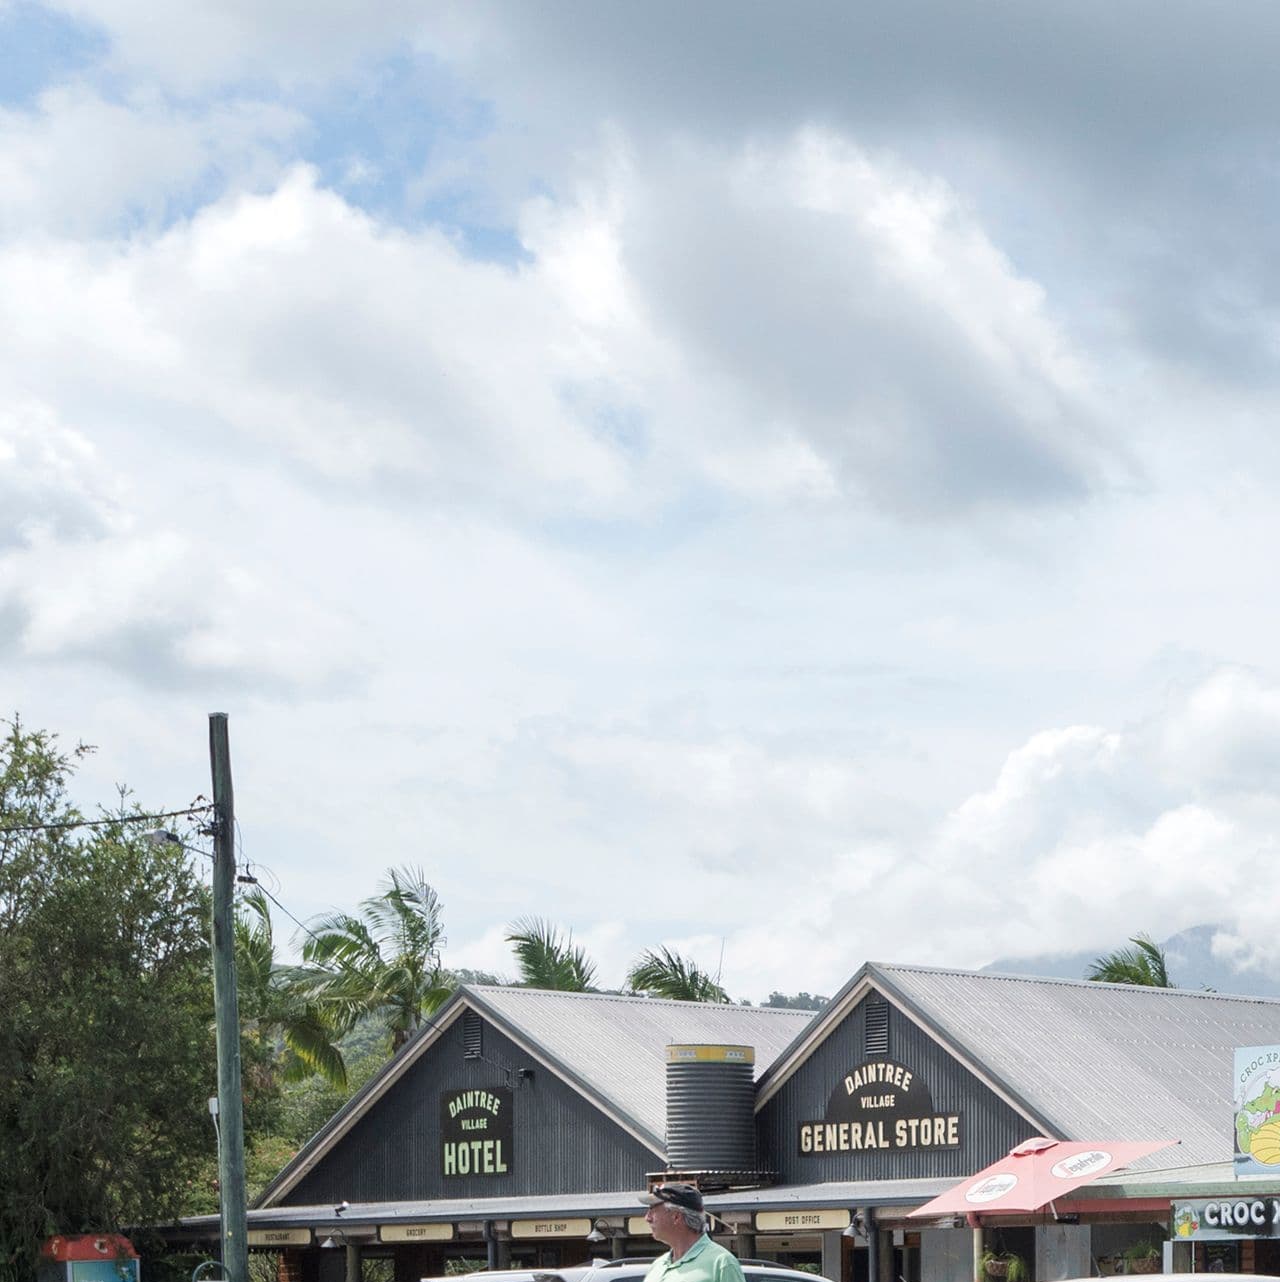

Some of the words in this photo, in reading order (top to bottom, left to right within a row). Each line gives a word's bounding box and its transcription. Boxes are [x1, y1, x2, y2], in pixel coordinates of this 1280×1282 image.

[844, 1063, 913, 1095] DAINTREE
[1240, 1056, 1264, 1084] CROC
[448, 1090, 501, 1118] DAINTREE
[861, 1094, 896, 1109] VILLAGE
[461, 1118, 488, 1130] VILLAGE
[801, 1120, 890, 1152] GENERAL
[895, 1116, 959, 1147] STORE
[444, 1140, 507, 1175] HOTEL
[785, 1215, 799, 1225] POST
[802, 1215, 820, 1225] OFFICE
[1204, 1201, 1265, 1226] CROC
[535, 1223, 553, 1233] BOTTLE
[554, 1223, 567, 1233] SHOP
